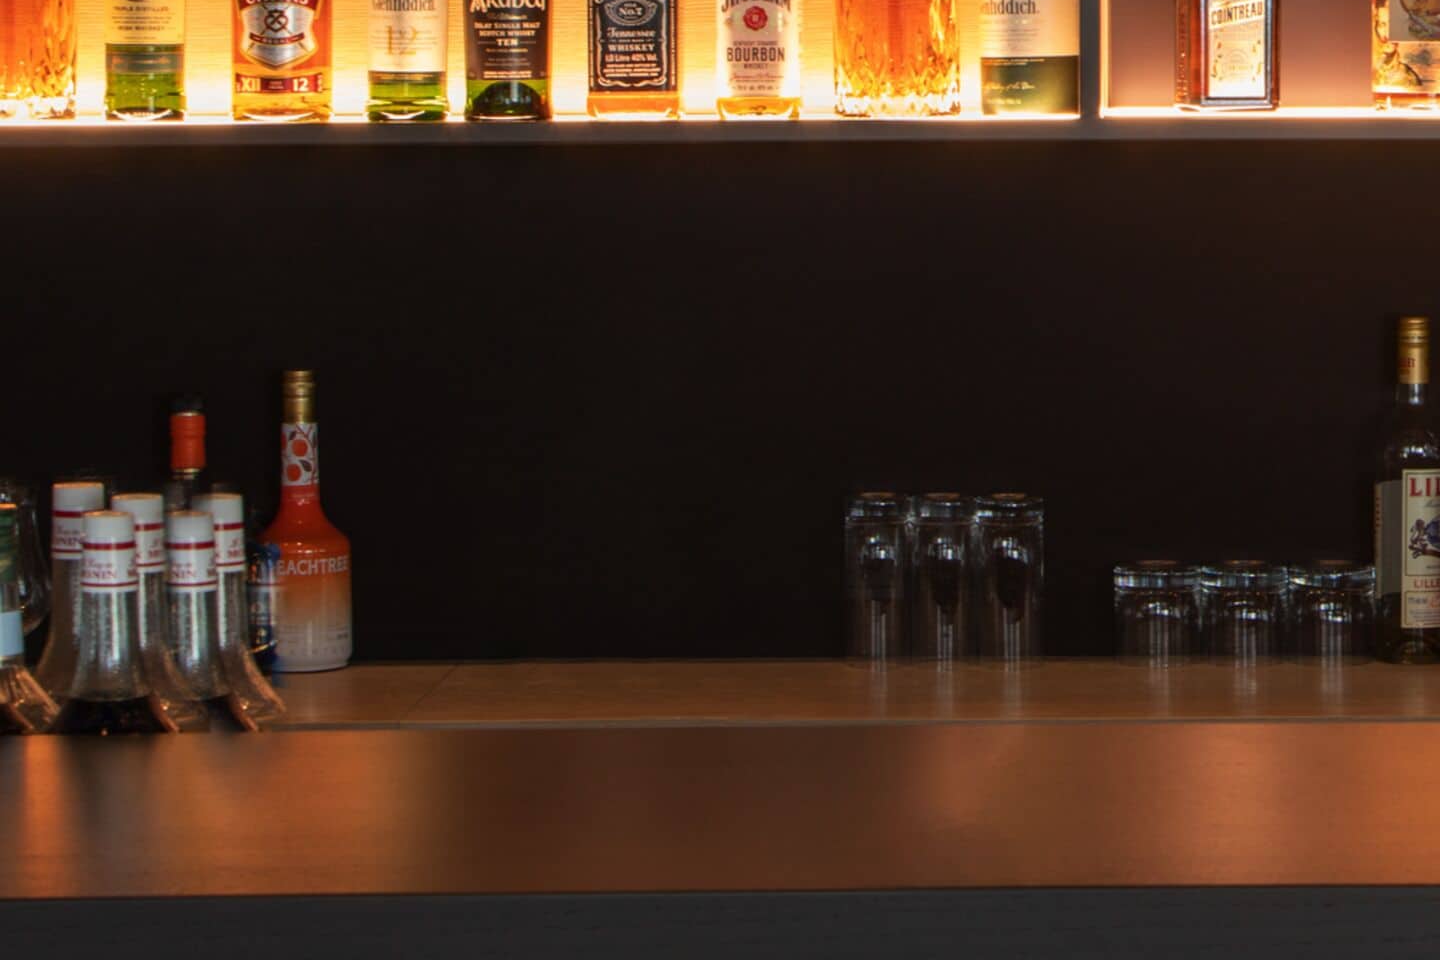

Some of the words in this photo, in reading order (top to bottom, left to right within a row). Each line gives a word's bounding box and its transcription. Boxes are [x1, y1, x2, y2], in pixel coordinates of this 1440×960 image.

[1211, 1, 1263, 25] COINTREAU
[385, 25, 417, 55] 12
[496, 38, 519, 47] TEN
[607, 43, 655, 52] WHISKEY
[726, 47, 785, 62] BOURBON
[240, 76, 262, 92] XII
[292, 78, 309, 93] 12
[275, 555, 350, 577] EACHTREE
